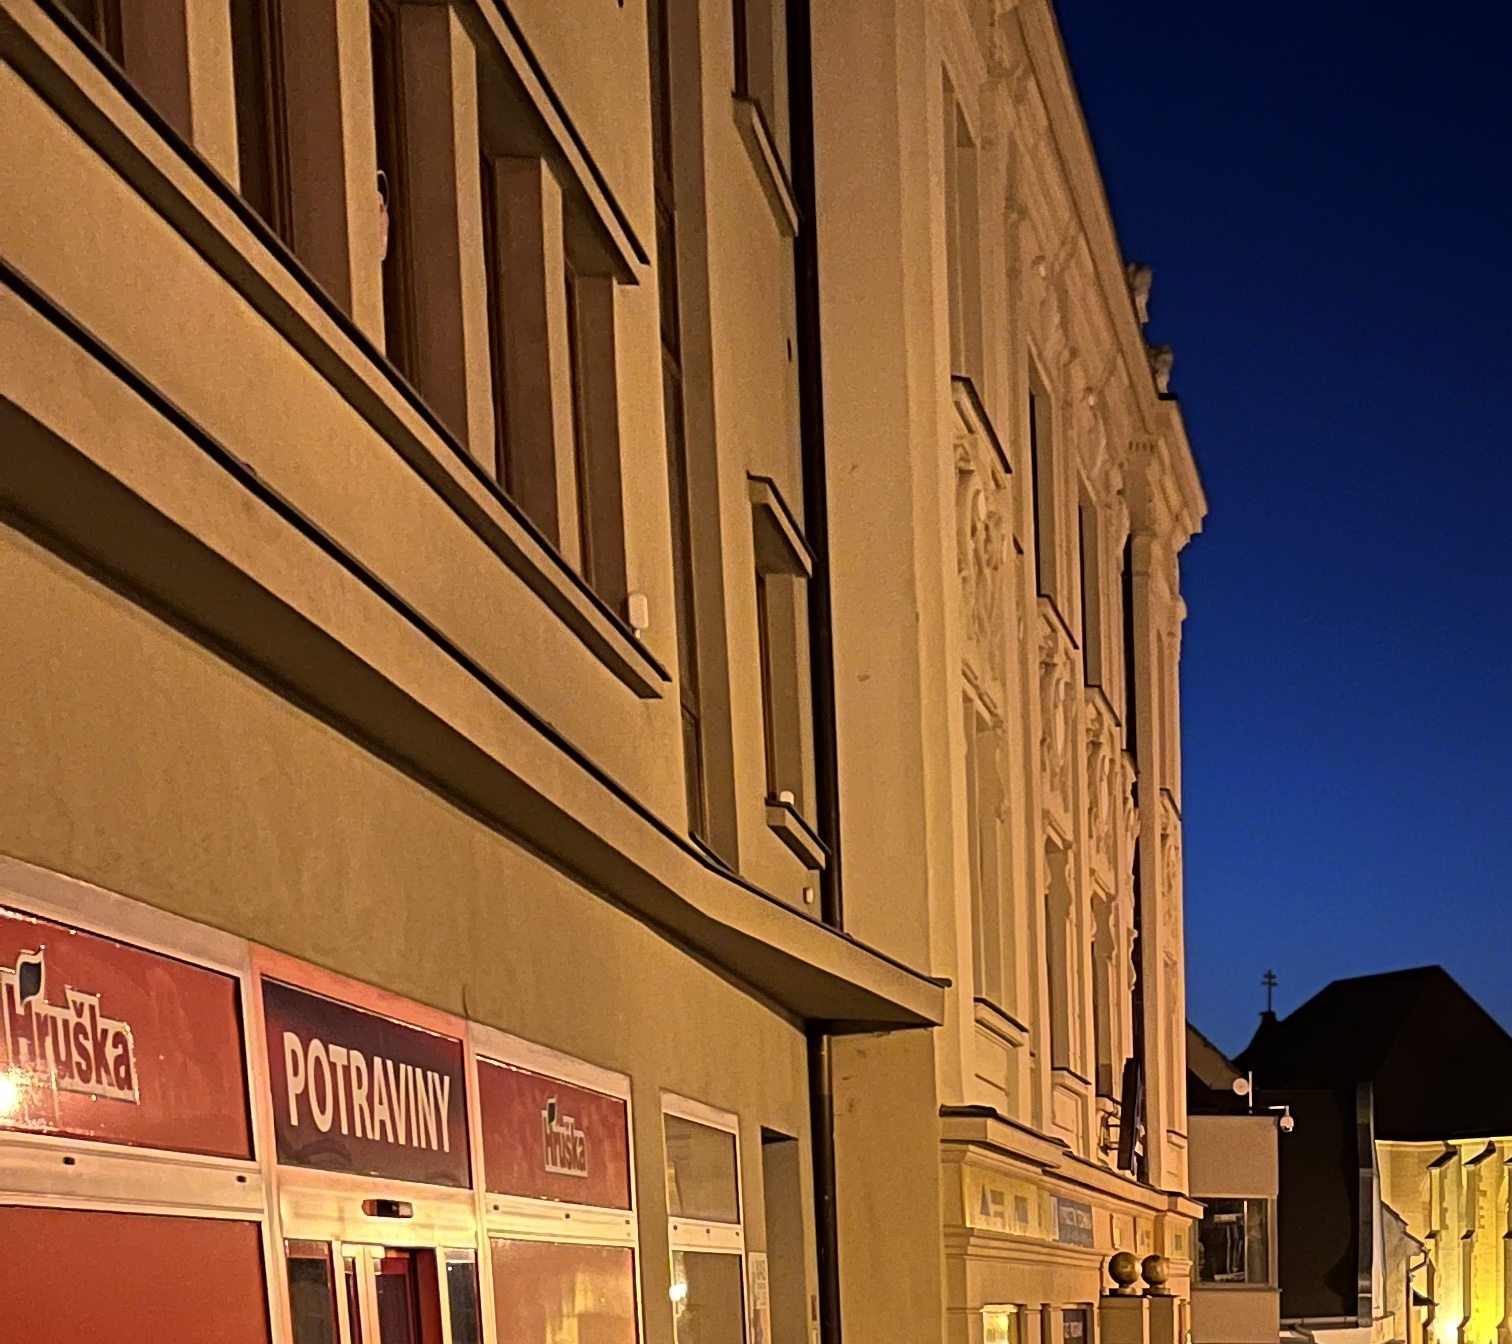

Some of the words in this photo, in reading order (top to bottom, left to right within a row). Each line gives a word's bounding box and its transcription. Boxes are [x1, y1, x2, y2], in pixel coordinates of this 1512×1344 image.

[5, 980, 133, 1091] Hruška
[282, 1031, 450, 1153] POTRAVINY
[543, 1115, 586, 1172] Hruška
